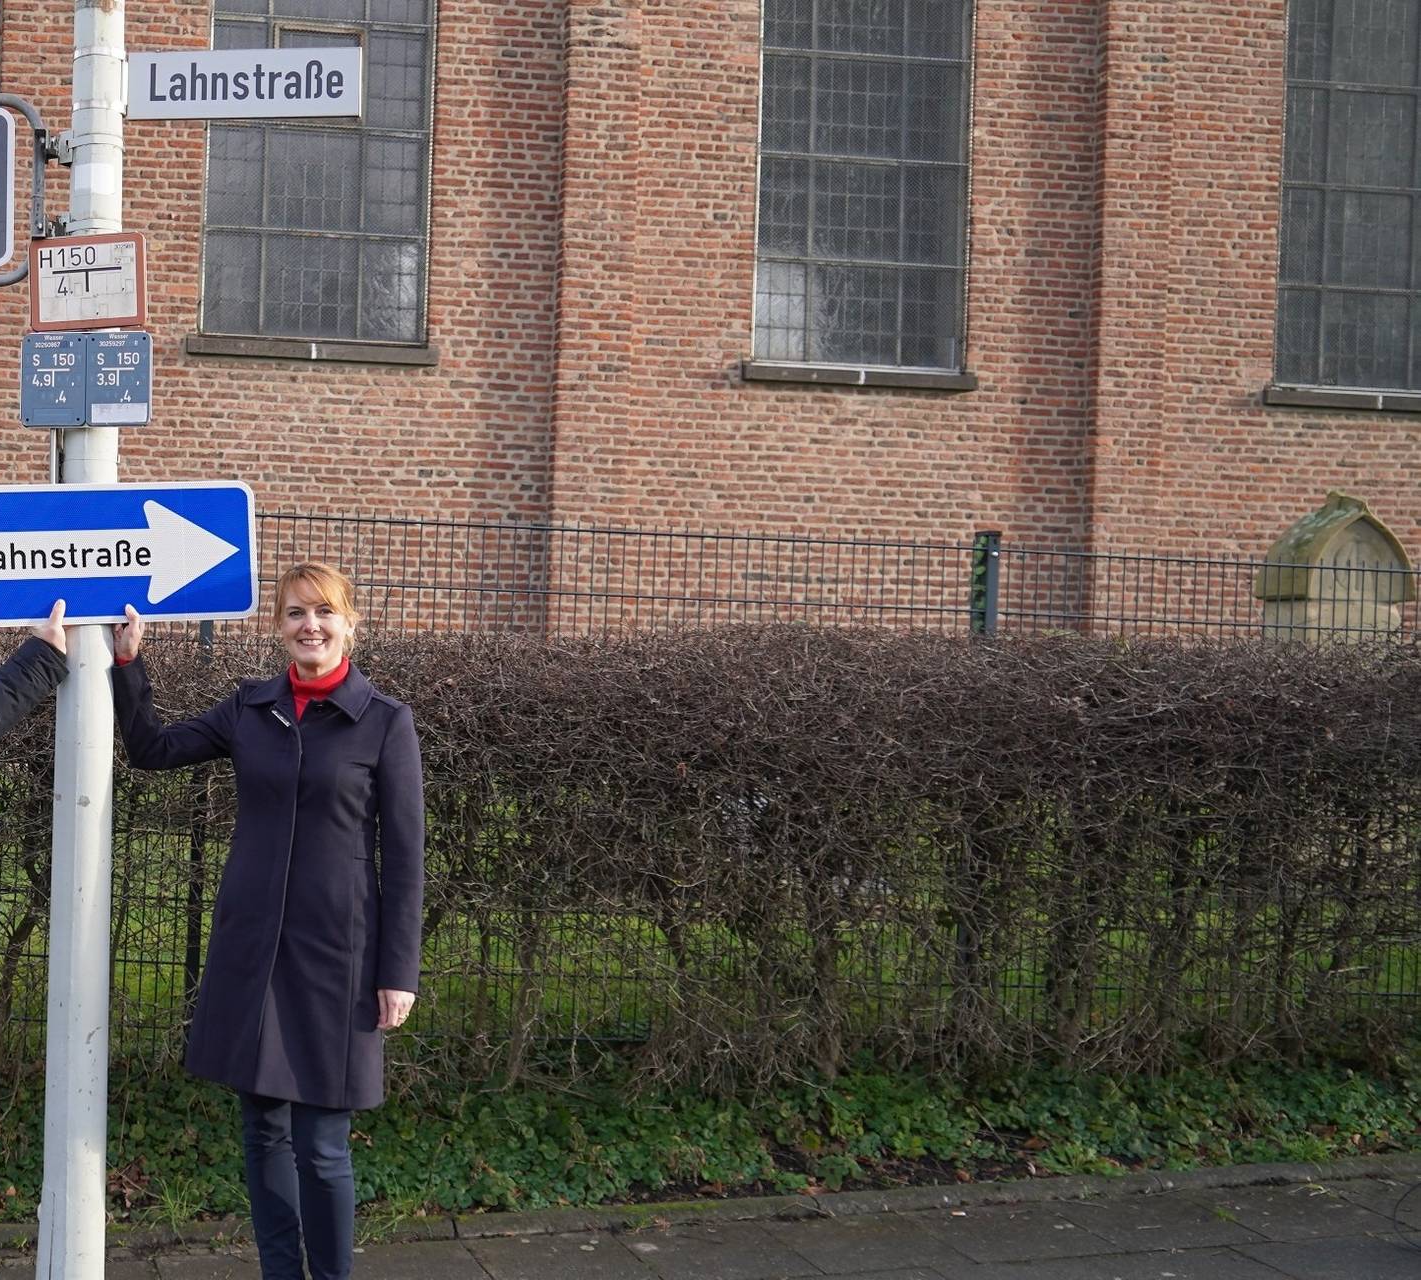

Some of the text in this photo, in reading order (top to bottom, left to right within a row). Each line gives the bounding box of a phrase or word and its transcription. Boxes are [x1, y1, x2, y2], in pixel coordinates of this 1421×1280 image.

[149, 60, 344, 102] Lahnstraße
[32, 353, 75, 367] S 150
[97, 352, 140, 365] S 150
